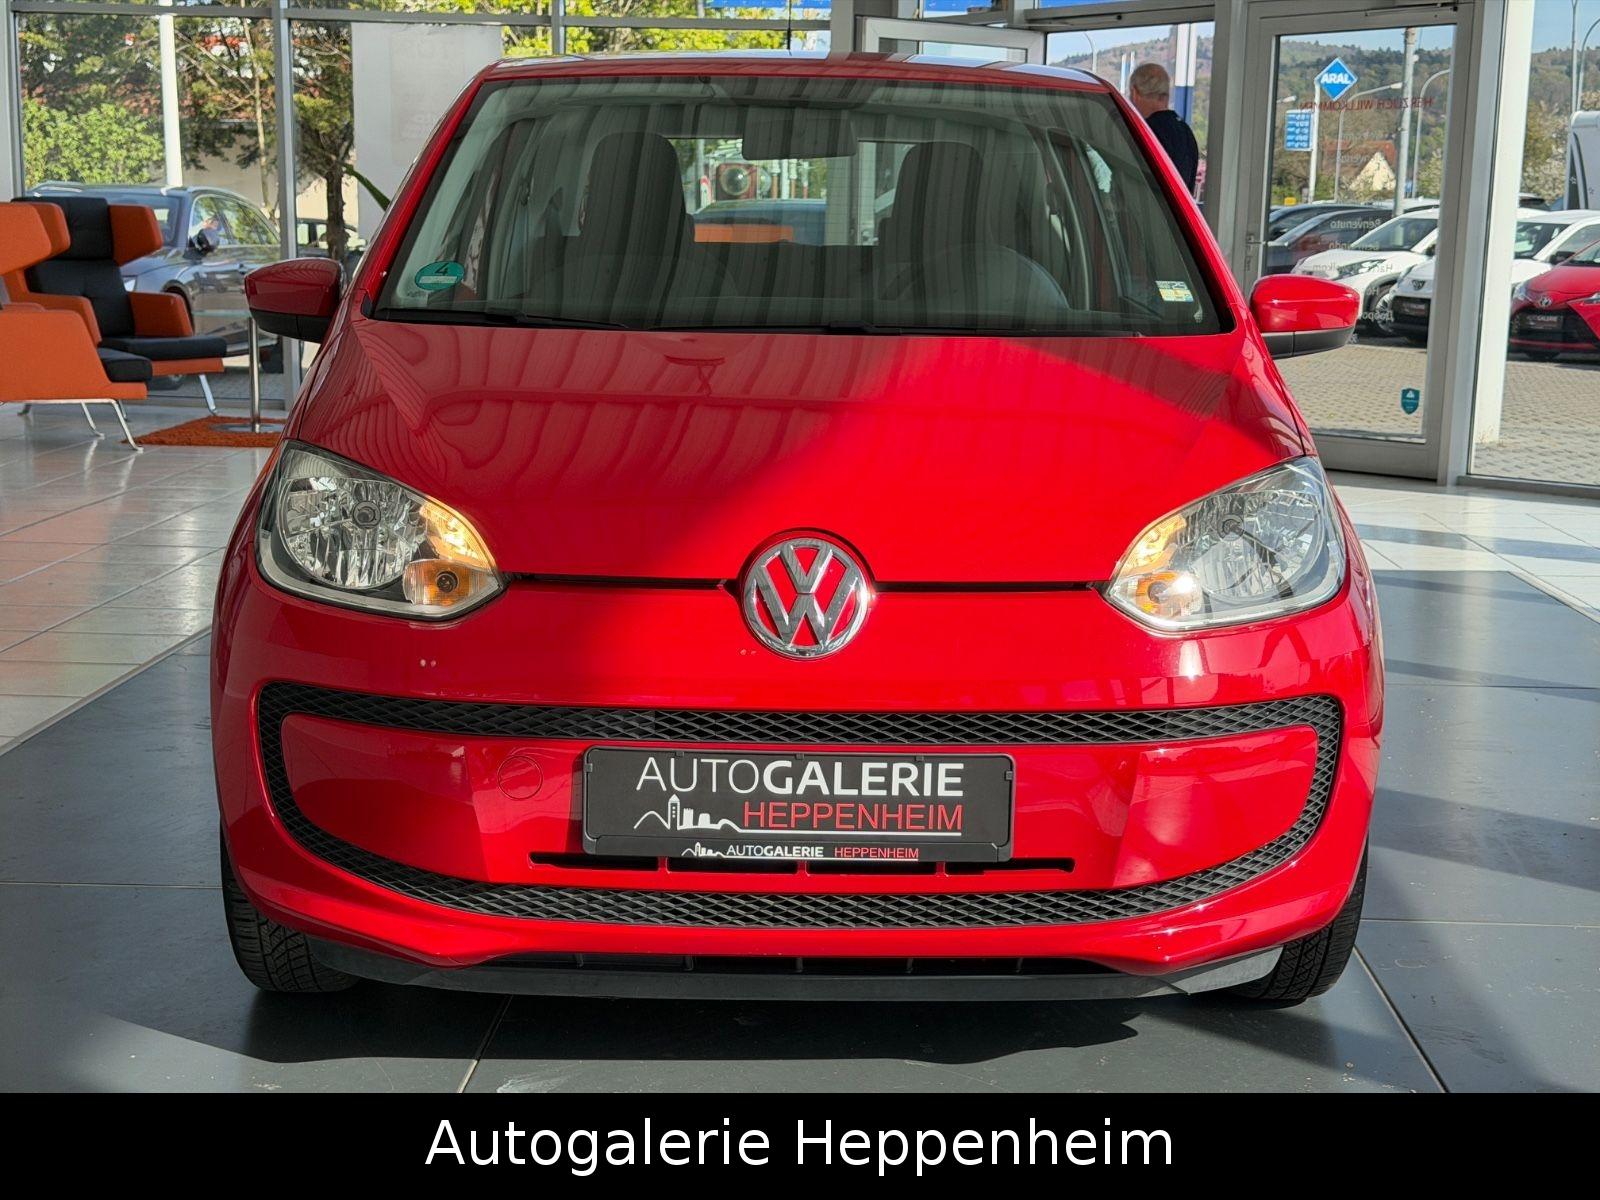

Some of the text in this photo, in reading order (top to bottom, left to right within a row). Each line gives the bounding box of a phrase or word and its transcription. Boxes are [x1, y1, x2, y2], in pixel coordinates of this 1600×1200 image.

[1320, 73, 1351, 85] ARAL
[434, 262, 449, 276] 4
[744, 538, 868, 656] VW
[635, 756, 965, 797] AUTOGALERIE
[742, 800, 963, 831] HEPPENHEIM
[726, 844, 920, 859] AUTOGALERIE HEPPENHEIM
